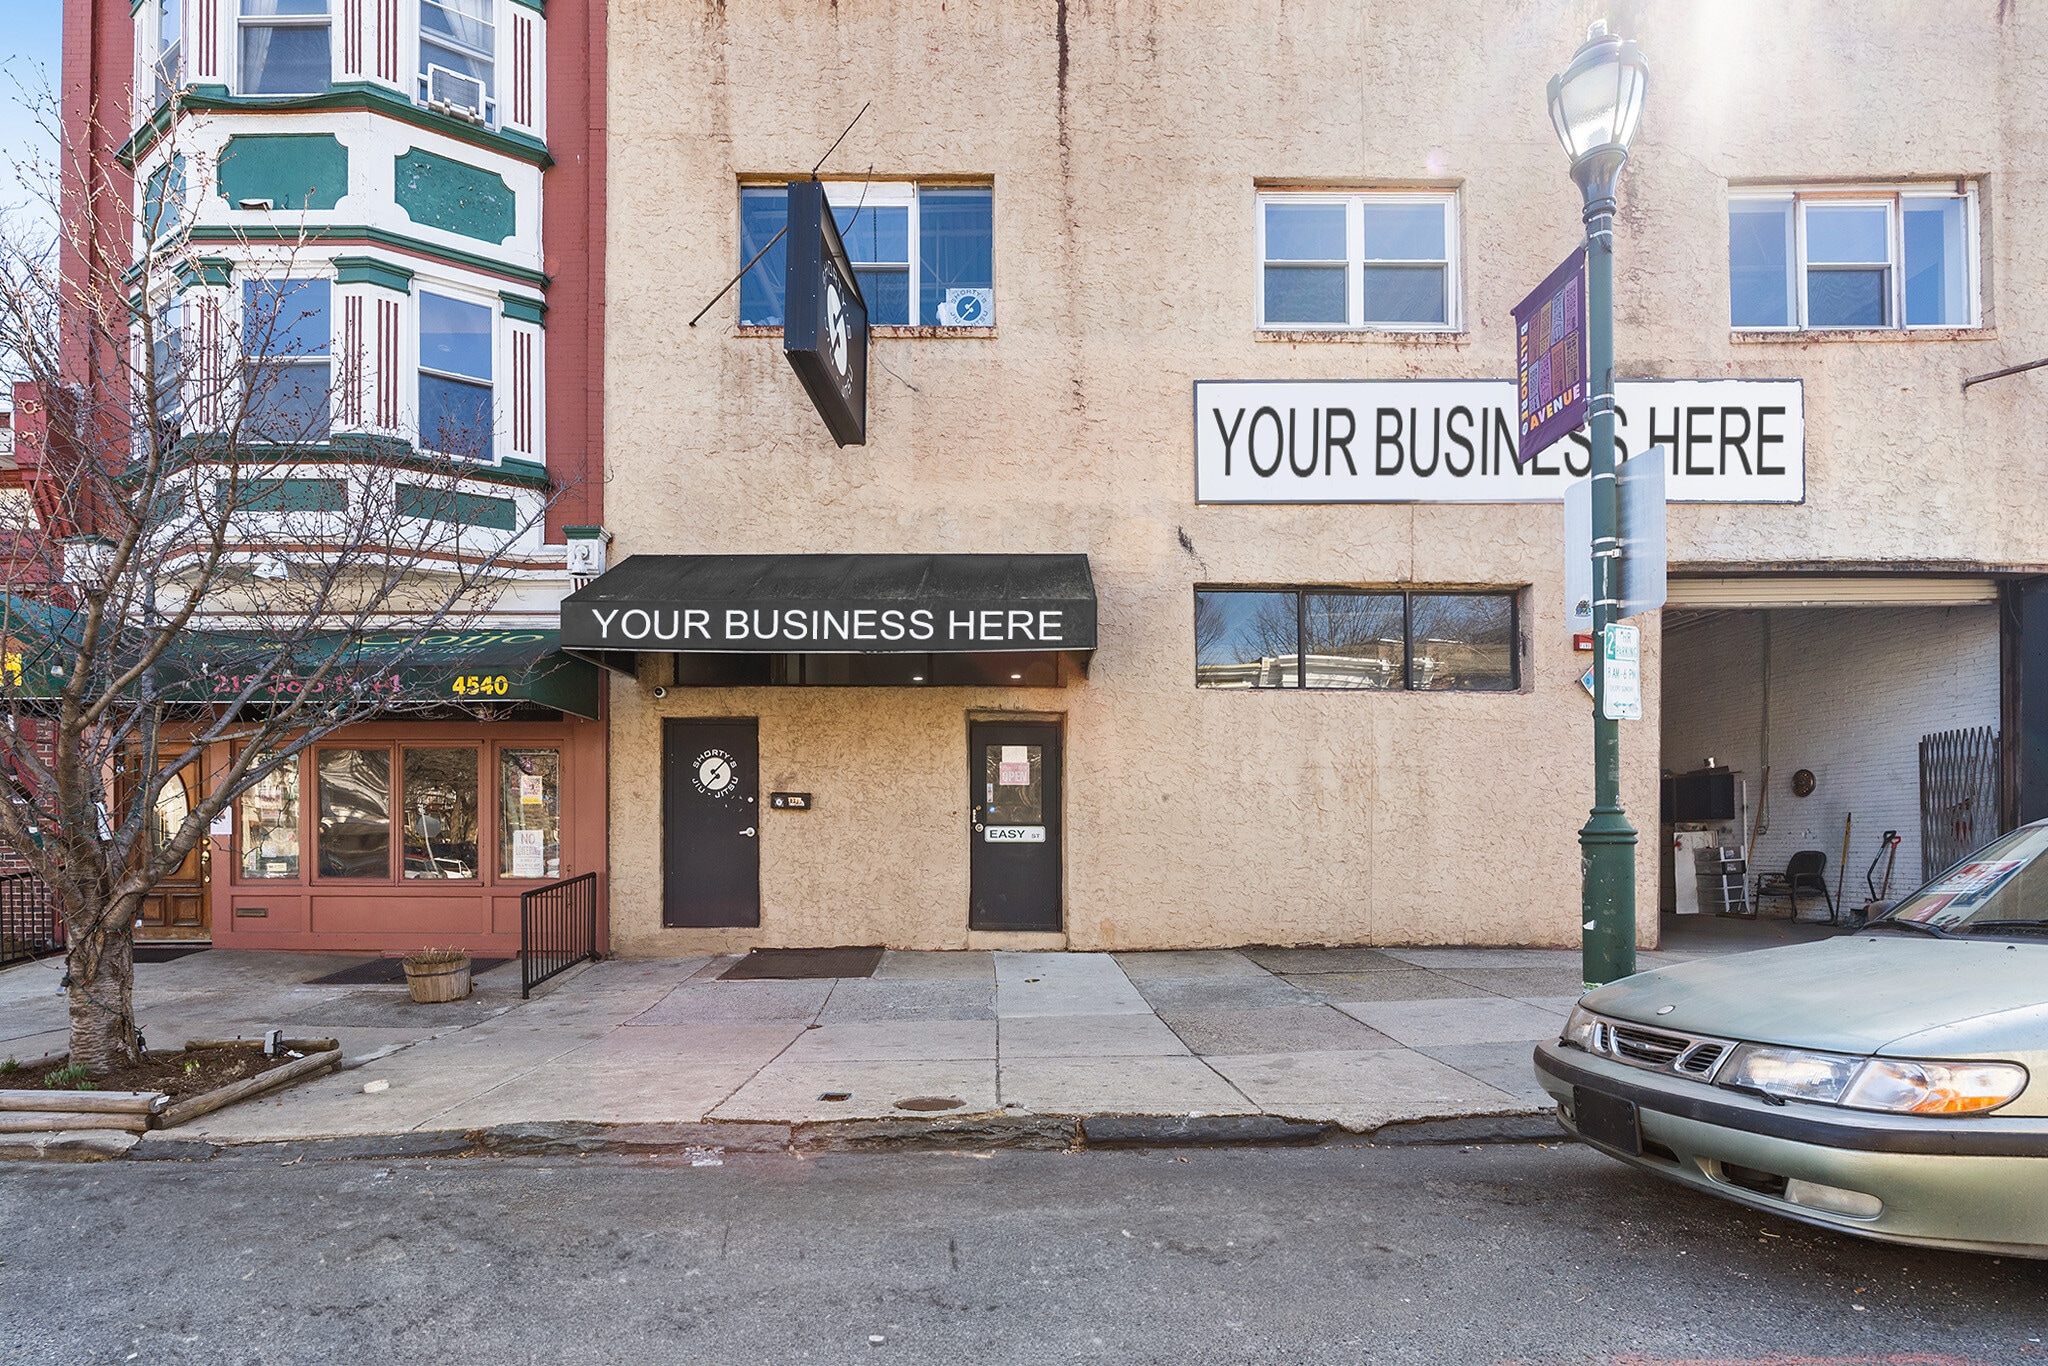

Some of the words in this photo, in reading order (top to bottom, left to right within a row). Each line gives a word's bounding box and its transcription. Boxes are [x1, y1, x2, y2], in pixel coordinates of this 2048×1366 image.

[1520, 321, 1529, 422] BALTIMORE
[1529, 382, 1581, 431] AVENUE
[1212, 405, 1358, 478] YOUR
[1649, 406, 1786, 476] HERE
[591, 608, 712, 640] YOUR
[725, 609, 934, 641] BUSINESS
[949, 609, 1063, 641] HERE
[1607, 631, 1614, 655] 2
[452, 675, 509, 695] 4540
[692, 749, 738, 769] SHORTY'S
[1001, 771, 1027, 782] OPEN
[520, 833, 535, 845] NO
[989, 829, 1026, 839] EASY
